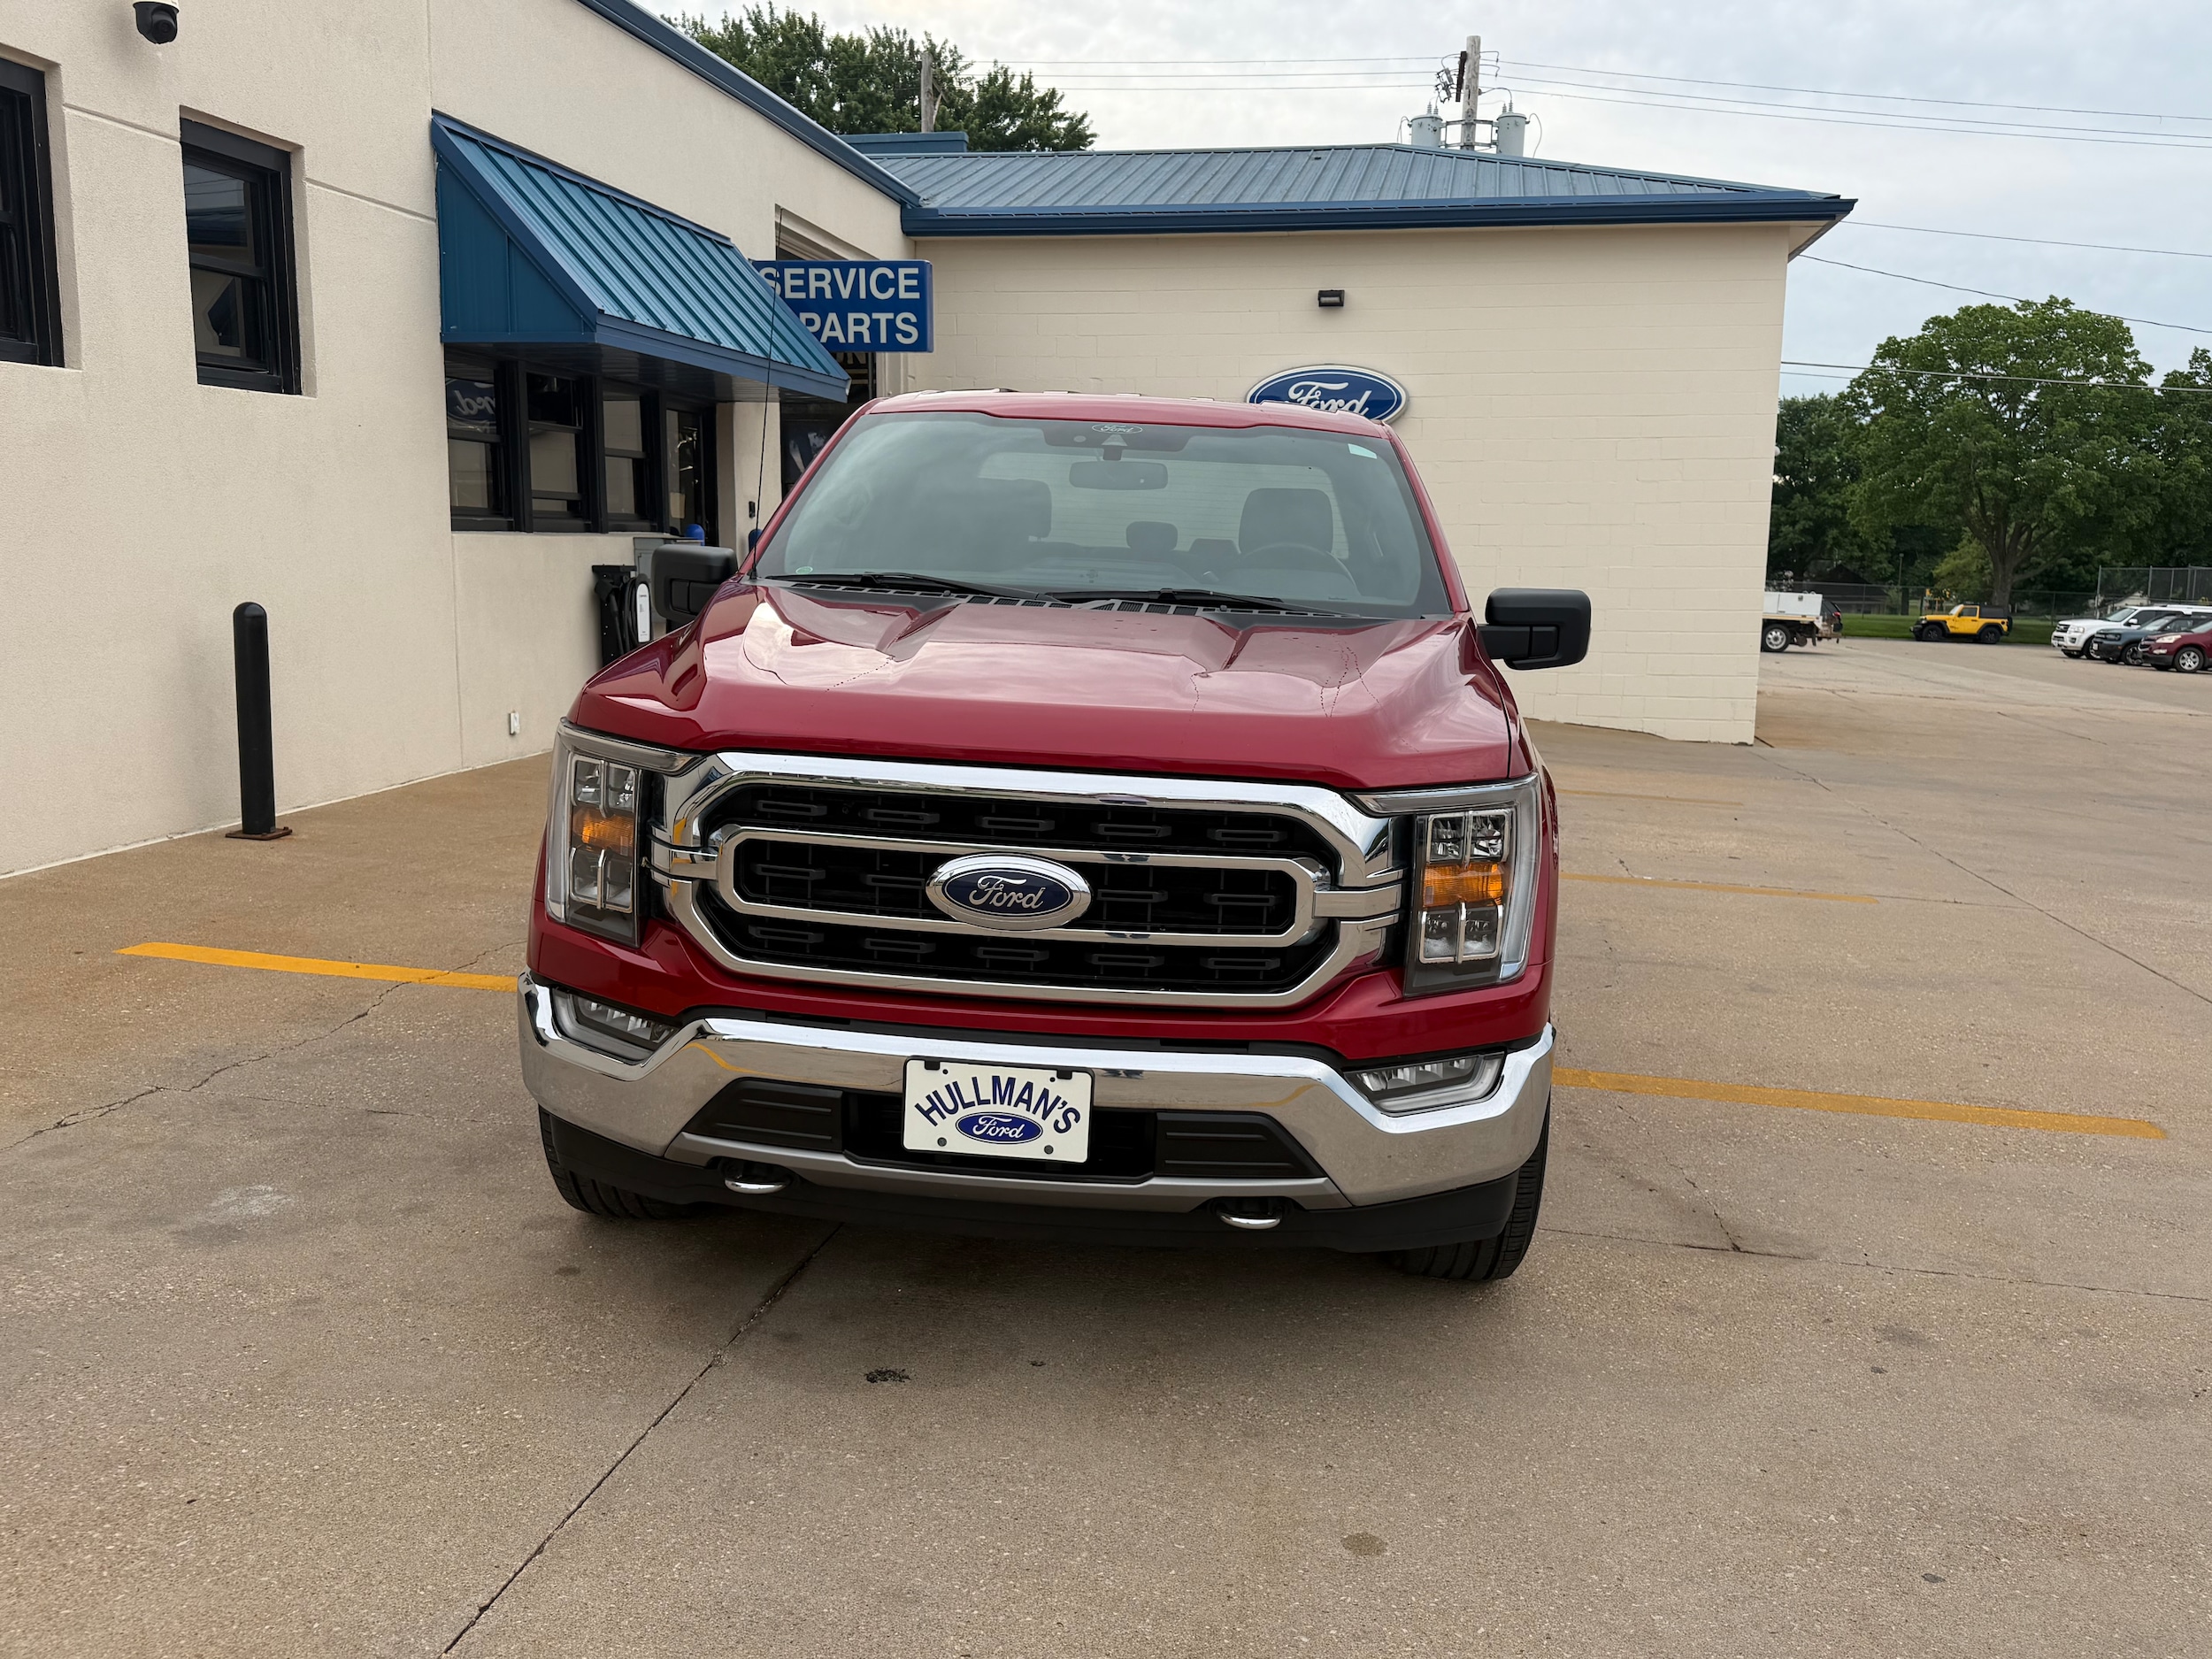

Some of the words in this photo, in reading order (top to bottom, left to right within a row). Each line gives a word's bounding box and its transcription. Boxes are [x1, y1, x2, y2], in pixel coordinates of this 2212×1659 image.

[759, 267, 920, 299] SERVICE
[799, 312, 918, 344] PARTS
[969, 875, 1046, 909] Ford
[914, 1075, 1081, 1133] HULLMAN'S
[972, 1115, 1025, 1139] Ford
